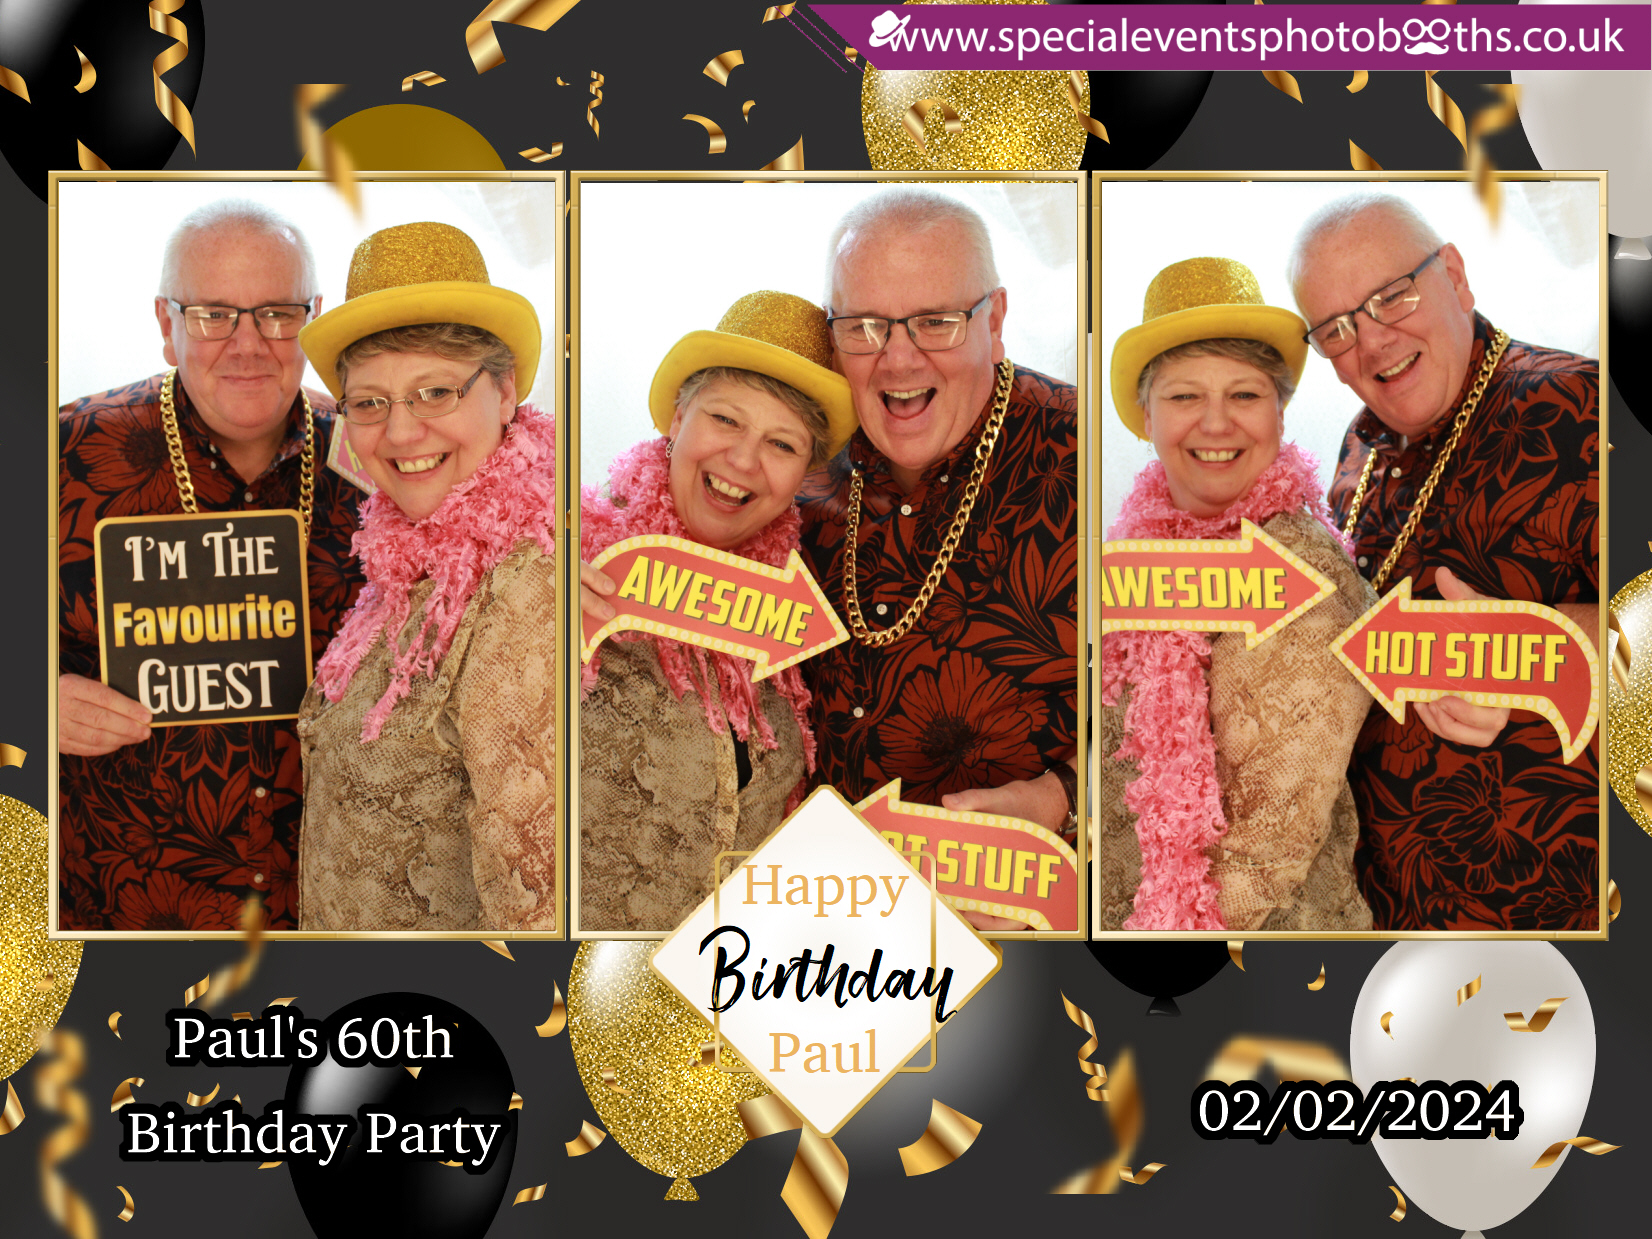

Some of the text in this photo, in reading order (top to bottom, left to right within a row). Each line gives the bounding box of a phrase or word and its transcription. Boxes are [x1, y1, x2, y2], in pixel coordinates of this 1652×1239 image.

[202, 521, 279, 577] THE
[112, 593, 296, 648] Favourite
[617, 554, 813, 647] AWESOME
[1365, 631, 1568, 683] HOT STUFF
[137, 658, 280, 714] GUEST
[937, 839, 1061, 898] STUFF
